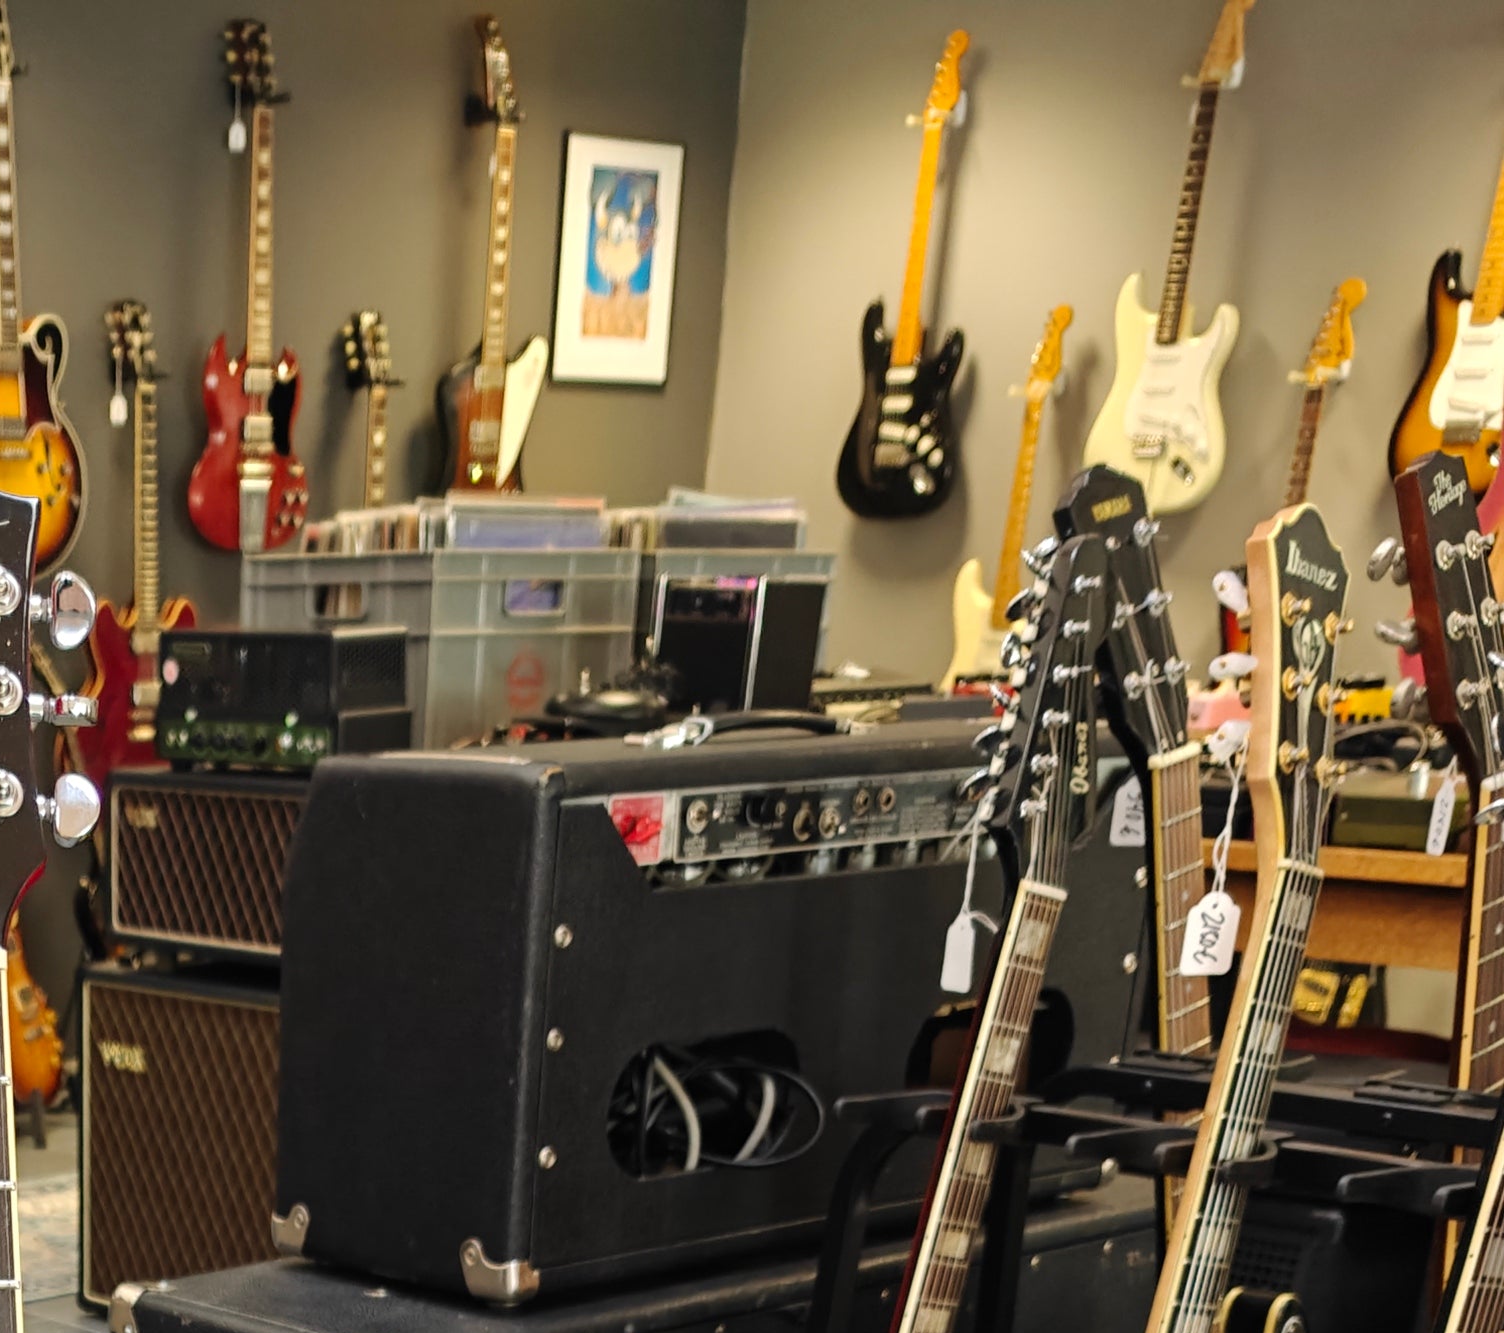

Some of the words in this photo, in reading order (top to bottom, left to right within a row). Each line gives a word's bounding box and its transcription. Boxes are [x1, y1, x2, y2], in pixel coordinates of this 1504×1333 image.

[1432, 469, 1453, 498] The
[1284, 539, 1339, 592] Ibanez
[1069, 721, 1090, 795] Ibanez
